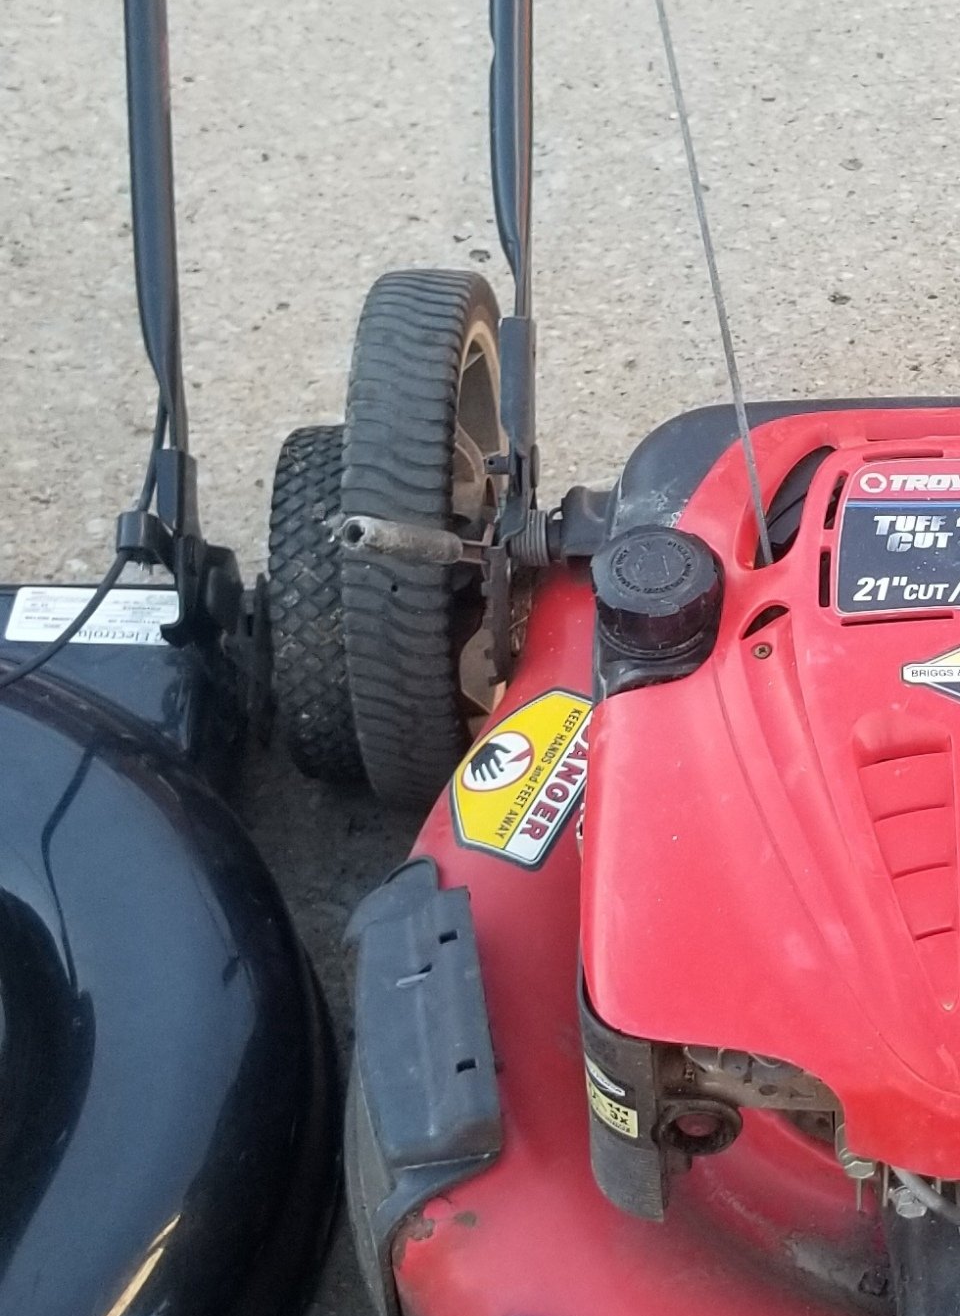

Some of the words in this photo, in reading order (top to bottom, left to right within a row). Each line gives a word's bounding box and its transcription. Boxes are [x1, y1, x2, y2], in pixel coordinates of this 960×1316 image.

[873, 515, 947, 535] TUFF
[886, 532, 954, 552] CUT
[911, 668, 954, 678] BRIGGS
[563, 708, 583, 733] KEEP
[541, 733, 568, 764] HANDS
[529, 766, 545, 784] and
[513, 786, 535, 808] FEET
[495, 809, 520, 839] AWAY
